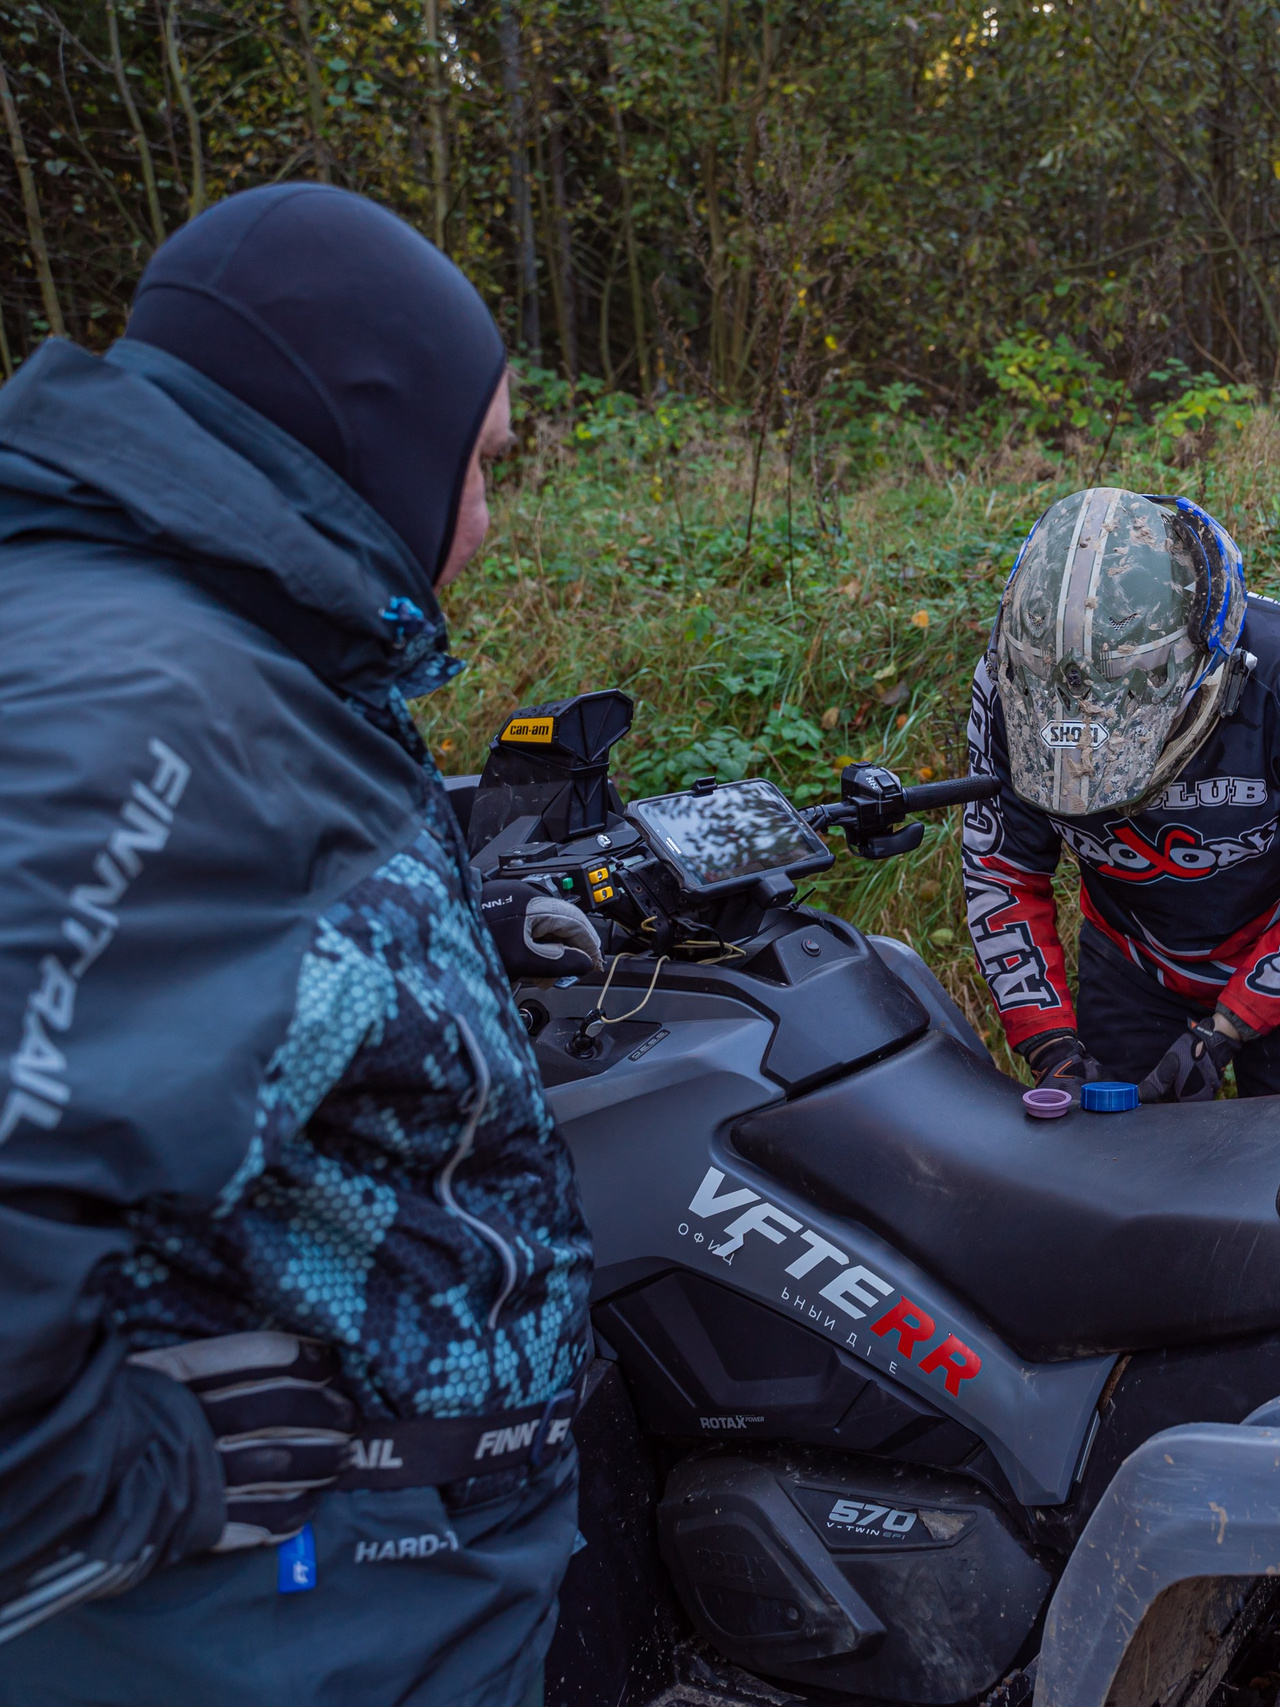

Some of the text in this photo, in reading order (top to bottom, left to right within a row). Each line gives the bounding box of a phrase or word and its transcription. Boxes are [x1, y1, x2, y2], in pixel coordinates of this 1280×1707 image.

[509, 725, 550, 736] can-am
[1050, 726, 1099, 743] SHOI
[1148, 778, 1267, 809] LUB
[700, 1416, 747, 1429] ROTAX
[828, 1499, 918, 1532] 570
